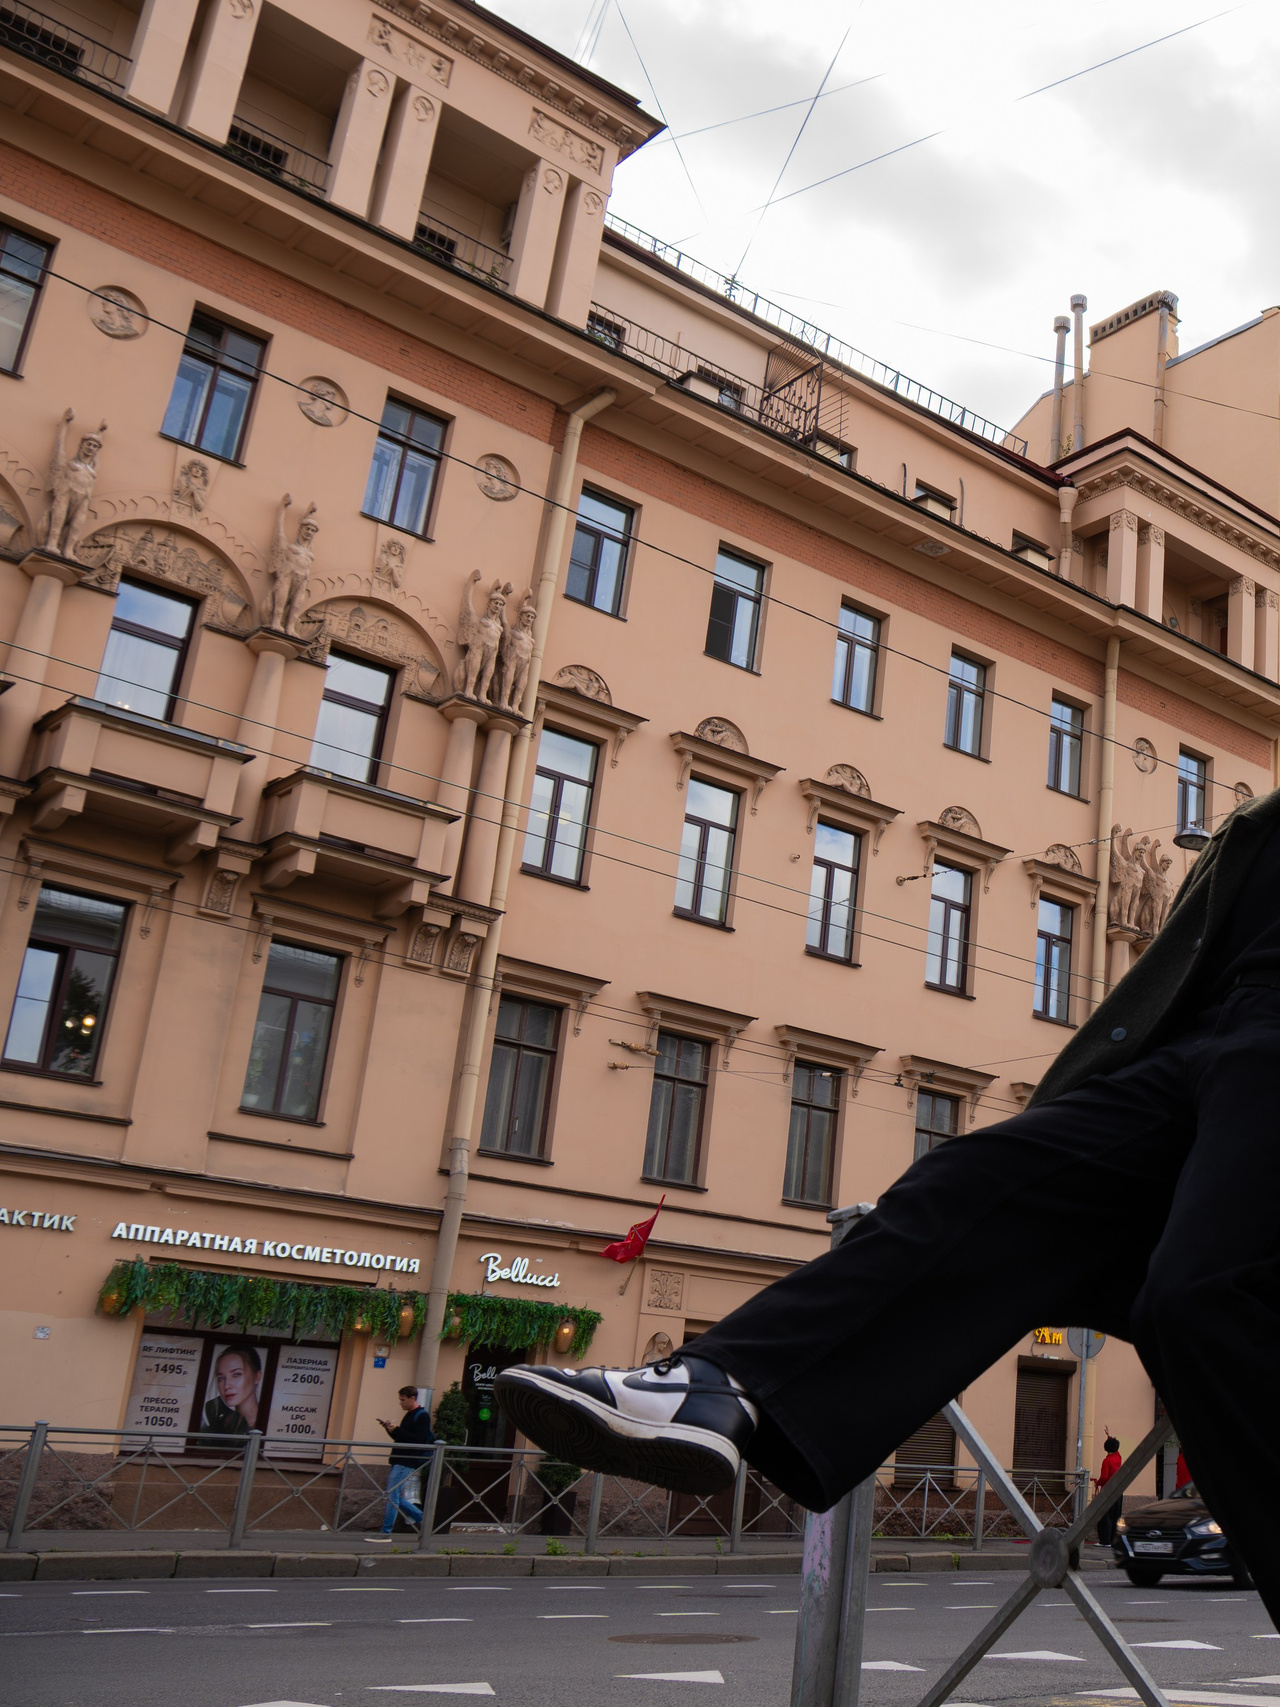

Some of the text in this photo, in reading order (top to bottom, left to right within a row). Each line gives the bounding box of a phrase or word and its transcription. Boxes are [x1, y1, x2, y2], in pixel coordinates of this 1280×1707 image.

[111, 1222, 420, 1274] АППАРАТНАЯ КОСМЕТОЛОГИЯ
[480, 1252, 561, 1288] Bellucci
[155, 1346, 198, 1356] ЛИФТИНГ
[286, 1357, 328, 1366] ЛАЗЕРНАЯ
[143, 1396, 178, 1405] ПРЕССО
[139, 1405, 180, 1413] ТЕРАПИЯ
[281, 1405, 318, 1414] МАССАЖ
